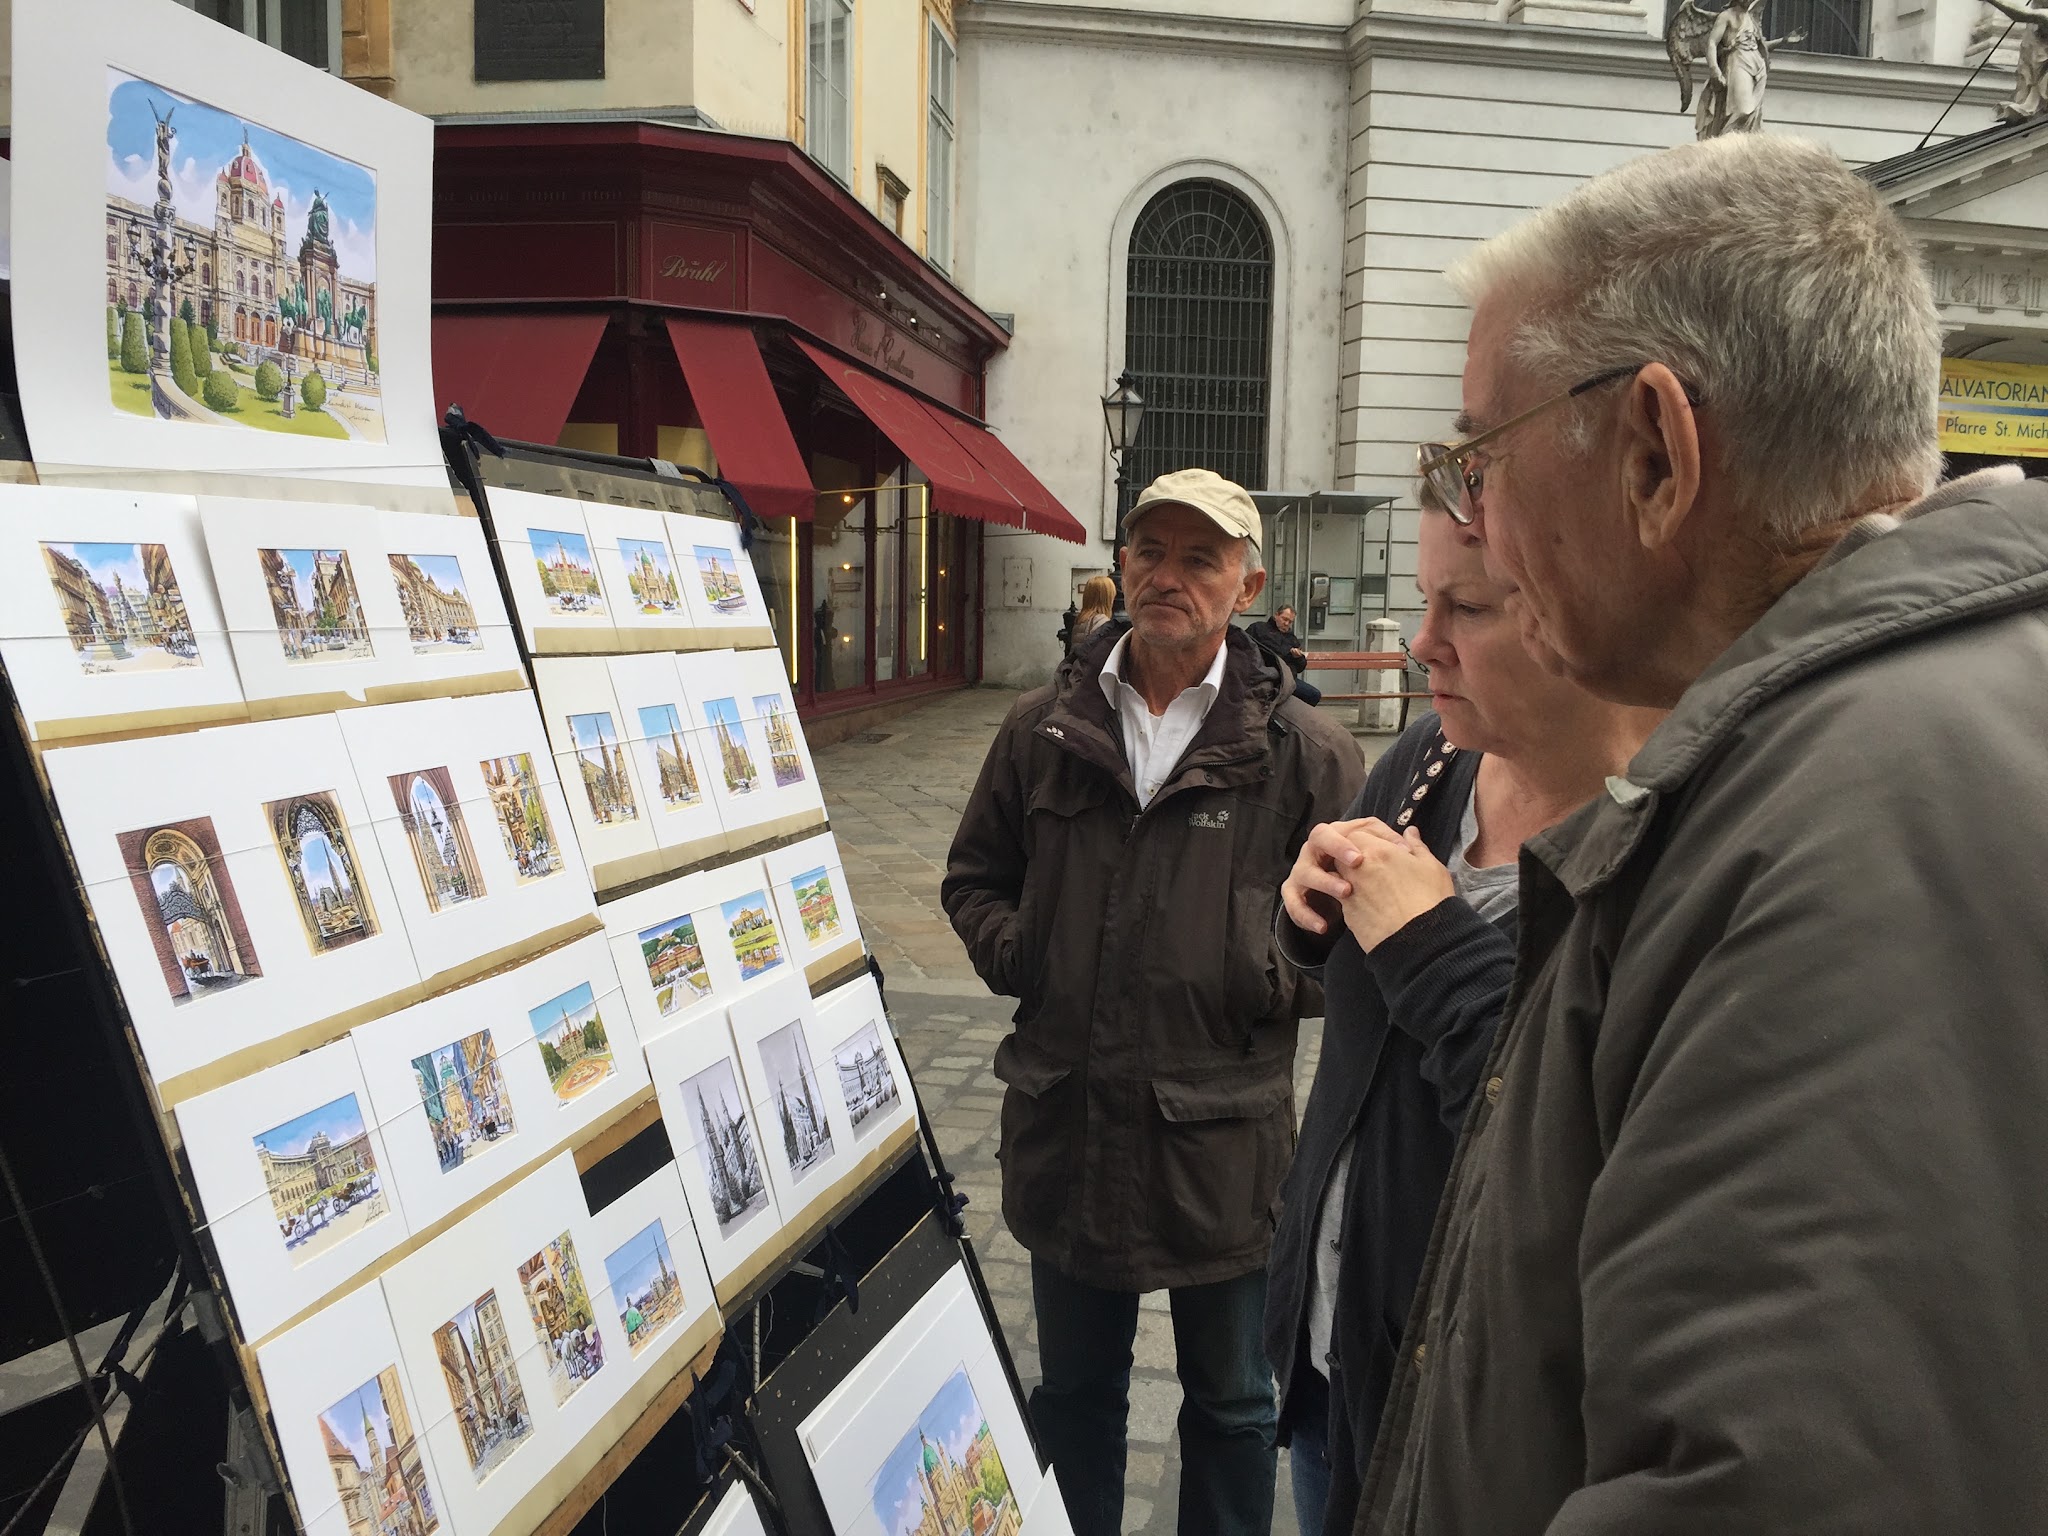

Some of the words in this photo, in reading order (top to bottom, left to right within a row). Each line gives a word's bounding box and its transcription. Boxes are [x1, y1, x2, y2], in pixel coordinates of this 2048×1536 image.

[659, 255, 727, 282] Brühl
[1945, 416, 1987, 435] Pfarre
[1995, 421, 2011, 437] St.
